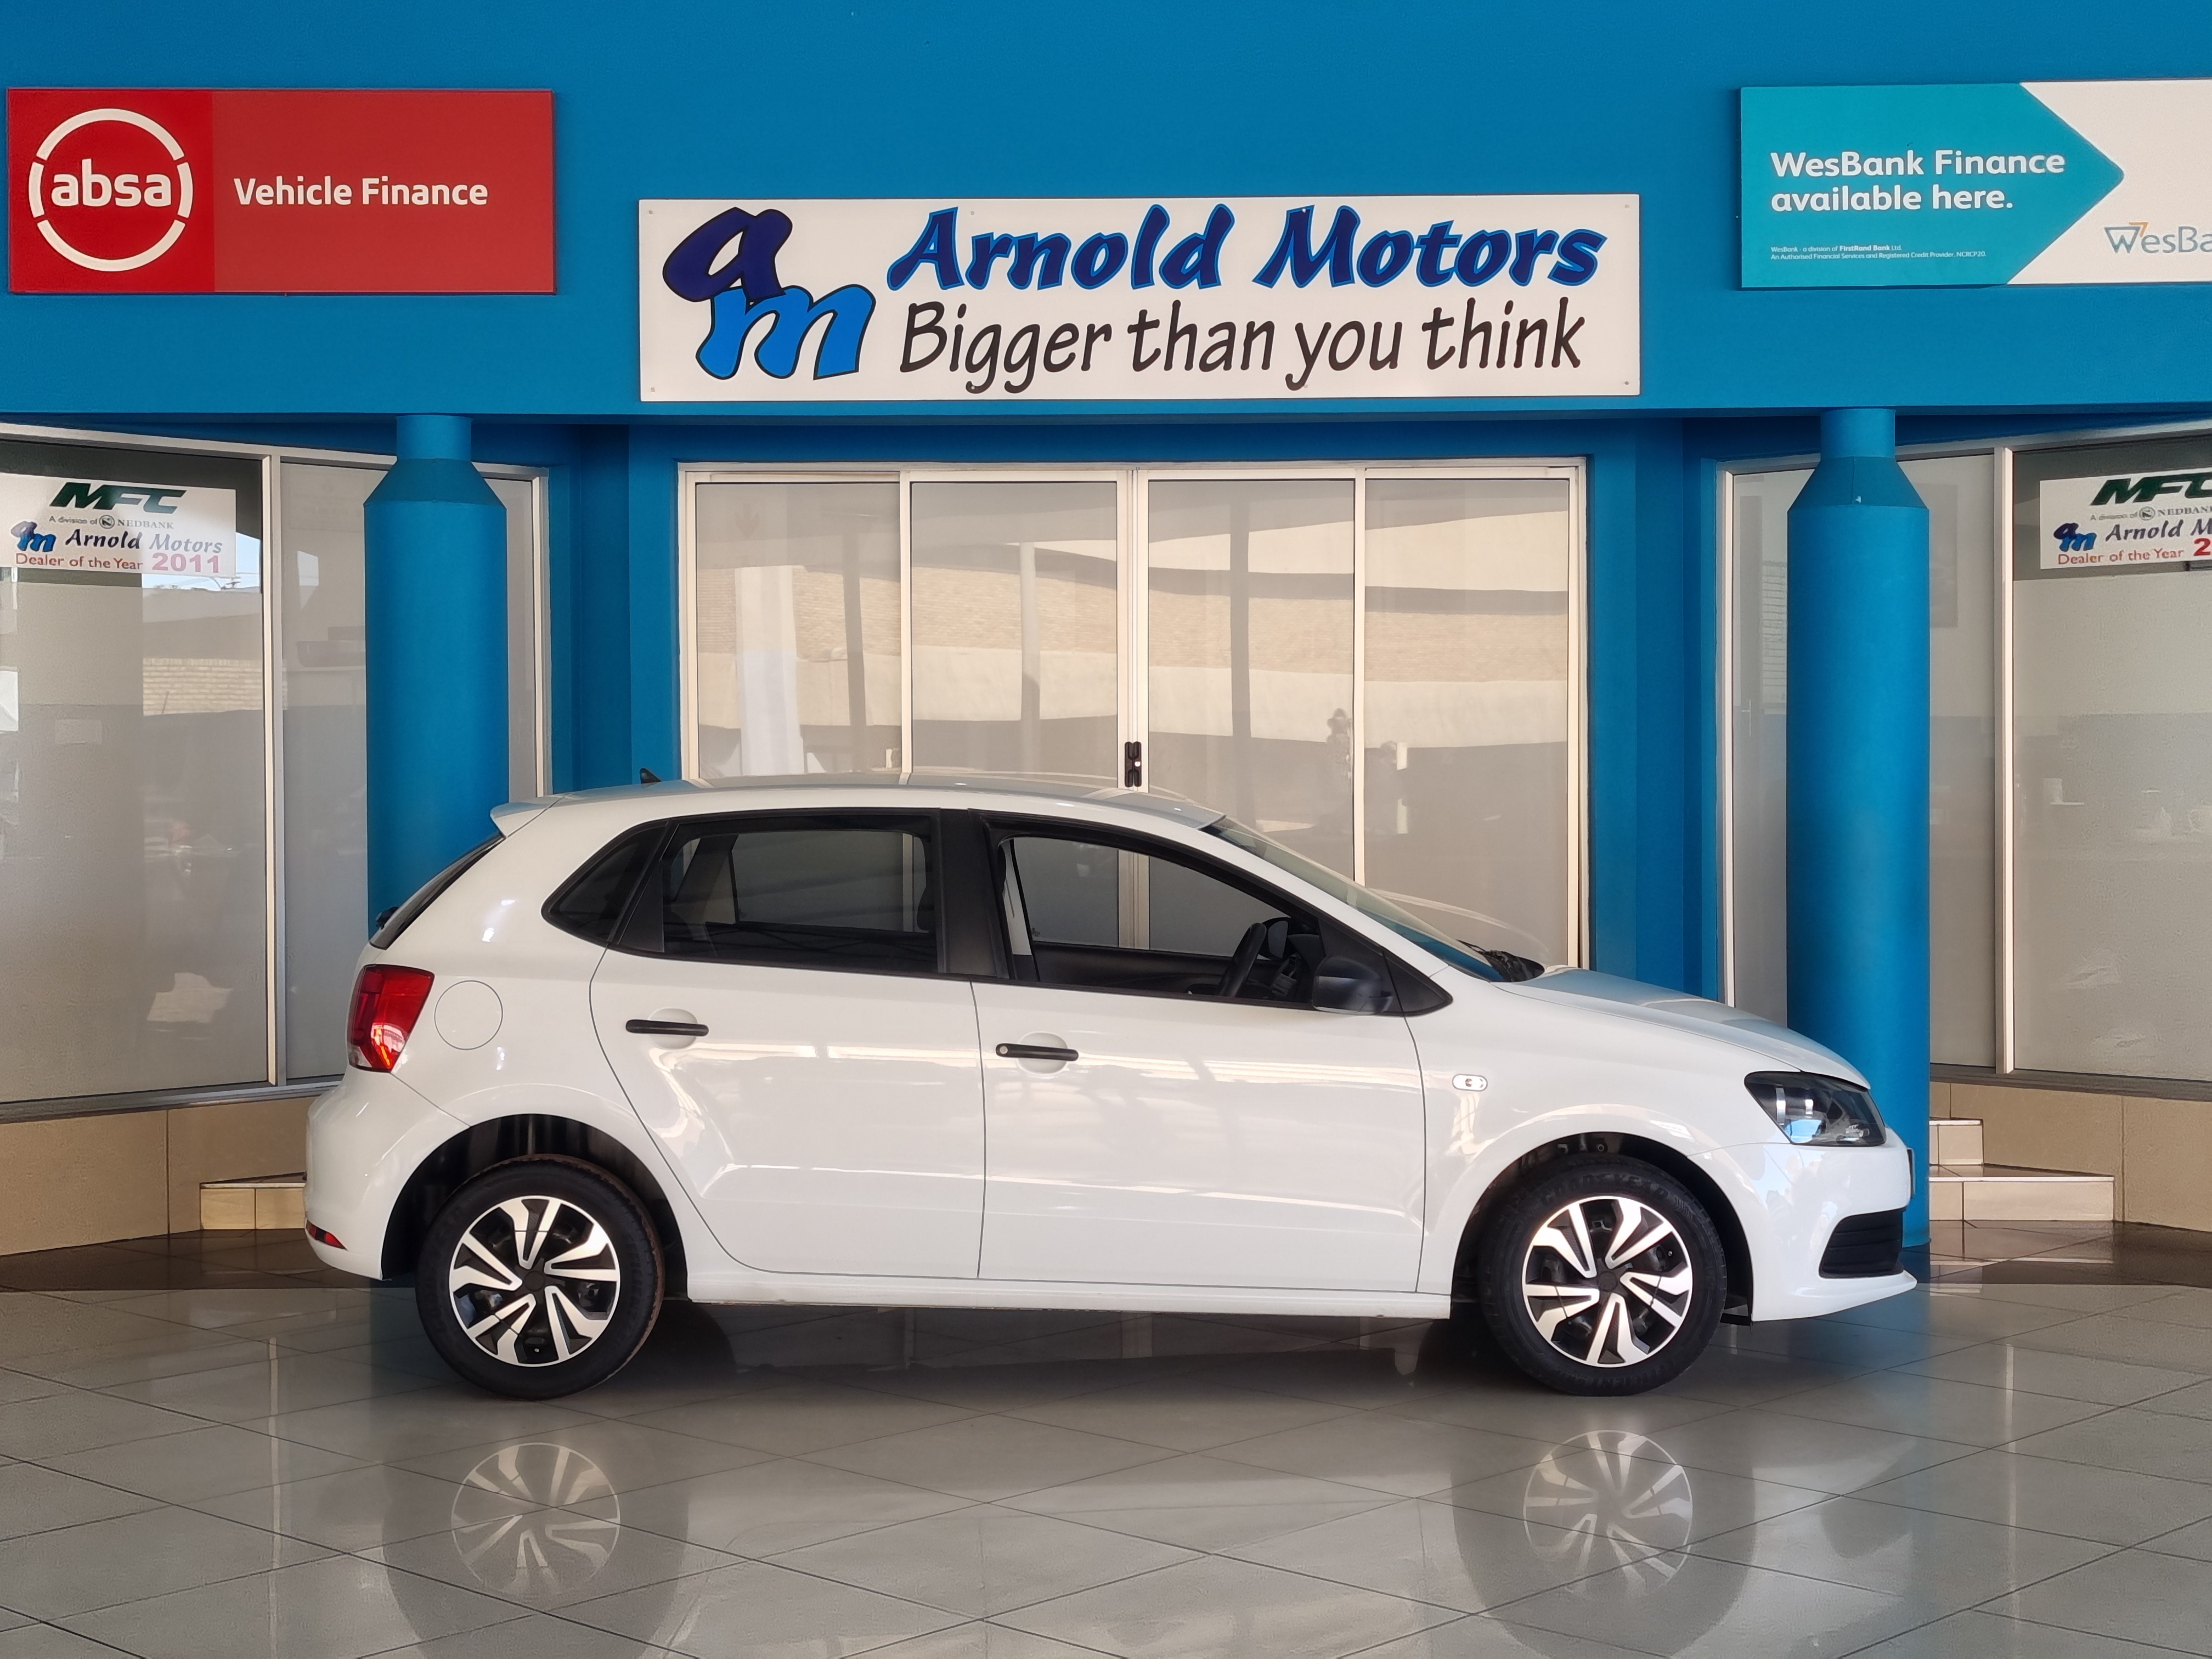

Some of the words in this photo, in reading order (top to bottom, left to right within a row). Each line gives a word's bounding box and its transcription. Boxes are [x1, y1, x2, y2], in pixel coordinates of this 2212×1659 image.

[1771, 150, 1924, 177] WesBank
[1936, 150, 2064, 174] Finance
[51, 159, 172, 207] absa
[234, 176, 352, 205] Vehicle
[363, 176, 488, 205] Finance
[1771, 185, 1922, 211] available
[1933, 184, 2012, 209] here.
[887, 204, 1235, 291] Arnold
[1252, 205, 1607, 288] Motors
[900, 301, 1112, 394] Bigger
[1127, 300, 1274, 372] than
[1285, 321, 1402, 391] you
[1422, 297, 1585, 370] think
[49, 482, 187, 514] MFC
[2158, 506, 2212, 517] NEDBAN
[117, 519, 174, 529] NEDBANK
[2105, 519, 2183, 541] Arnold
[65, 528, 143, 549] Arnold
[149, 533, 223, 554] Motors
[16, 553, 64, 566] Dealer
[70, 556, 84, 567] of
[88, 557, 110, 568] the
[113, 557, 143, 569] Year
[152, 552, 219, 573] 2011
[2058, 553, 2103, 565] Dealer
[2109, 550, 2124, 562] of
[2128, 549, 2149, 561] the
[2154, 547, 2184, 560] Year
